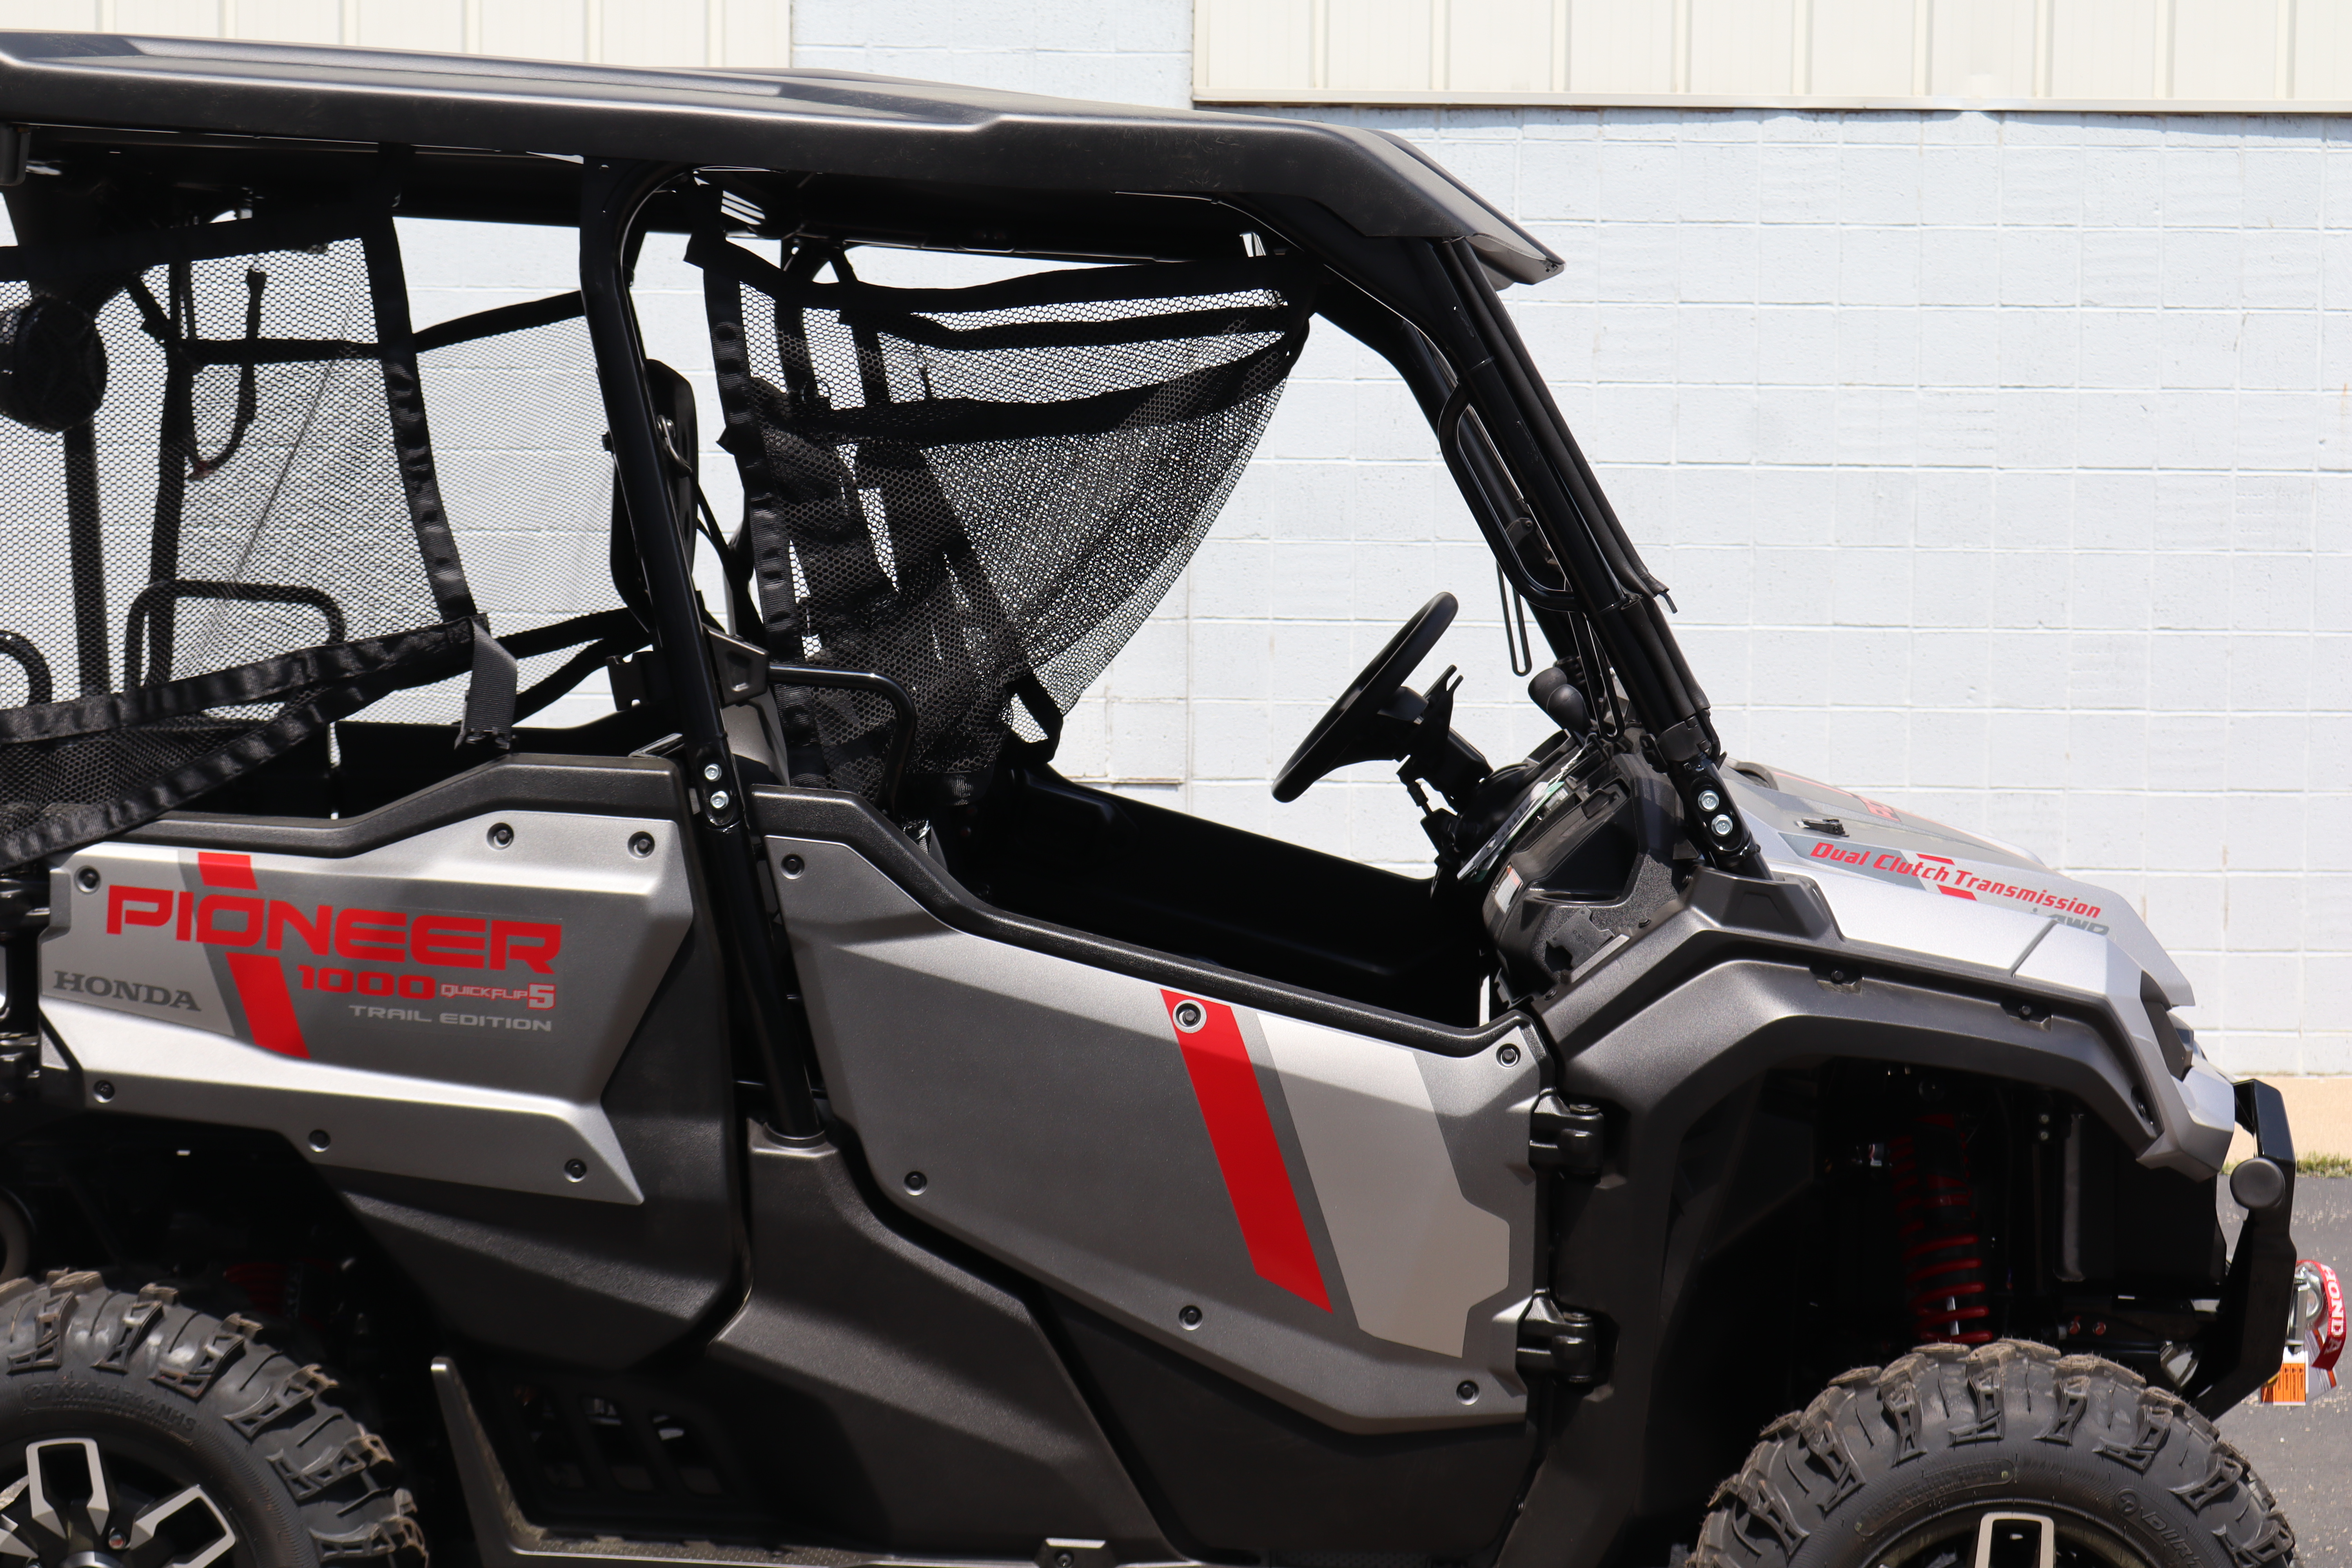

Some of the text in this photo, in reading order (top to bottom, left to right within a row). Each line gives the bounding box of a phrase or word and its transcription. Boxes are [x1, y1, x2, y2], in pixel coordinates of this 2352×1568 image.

[1810, 842, 2102, 918] Dual Clutch Transmission
[105, 884, 563, 975] PIONEER
[53, 970, 202, 1012] HONDA
[296, 964, 437, 1001] 1000
[348, 1004, 552, 1032] TRAIL EDITION
[2320, 1263, 2344, 1355] HONDA
